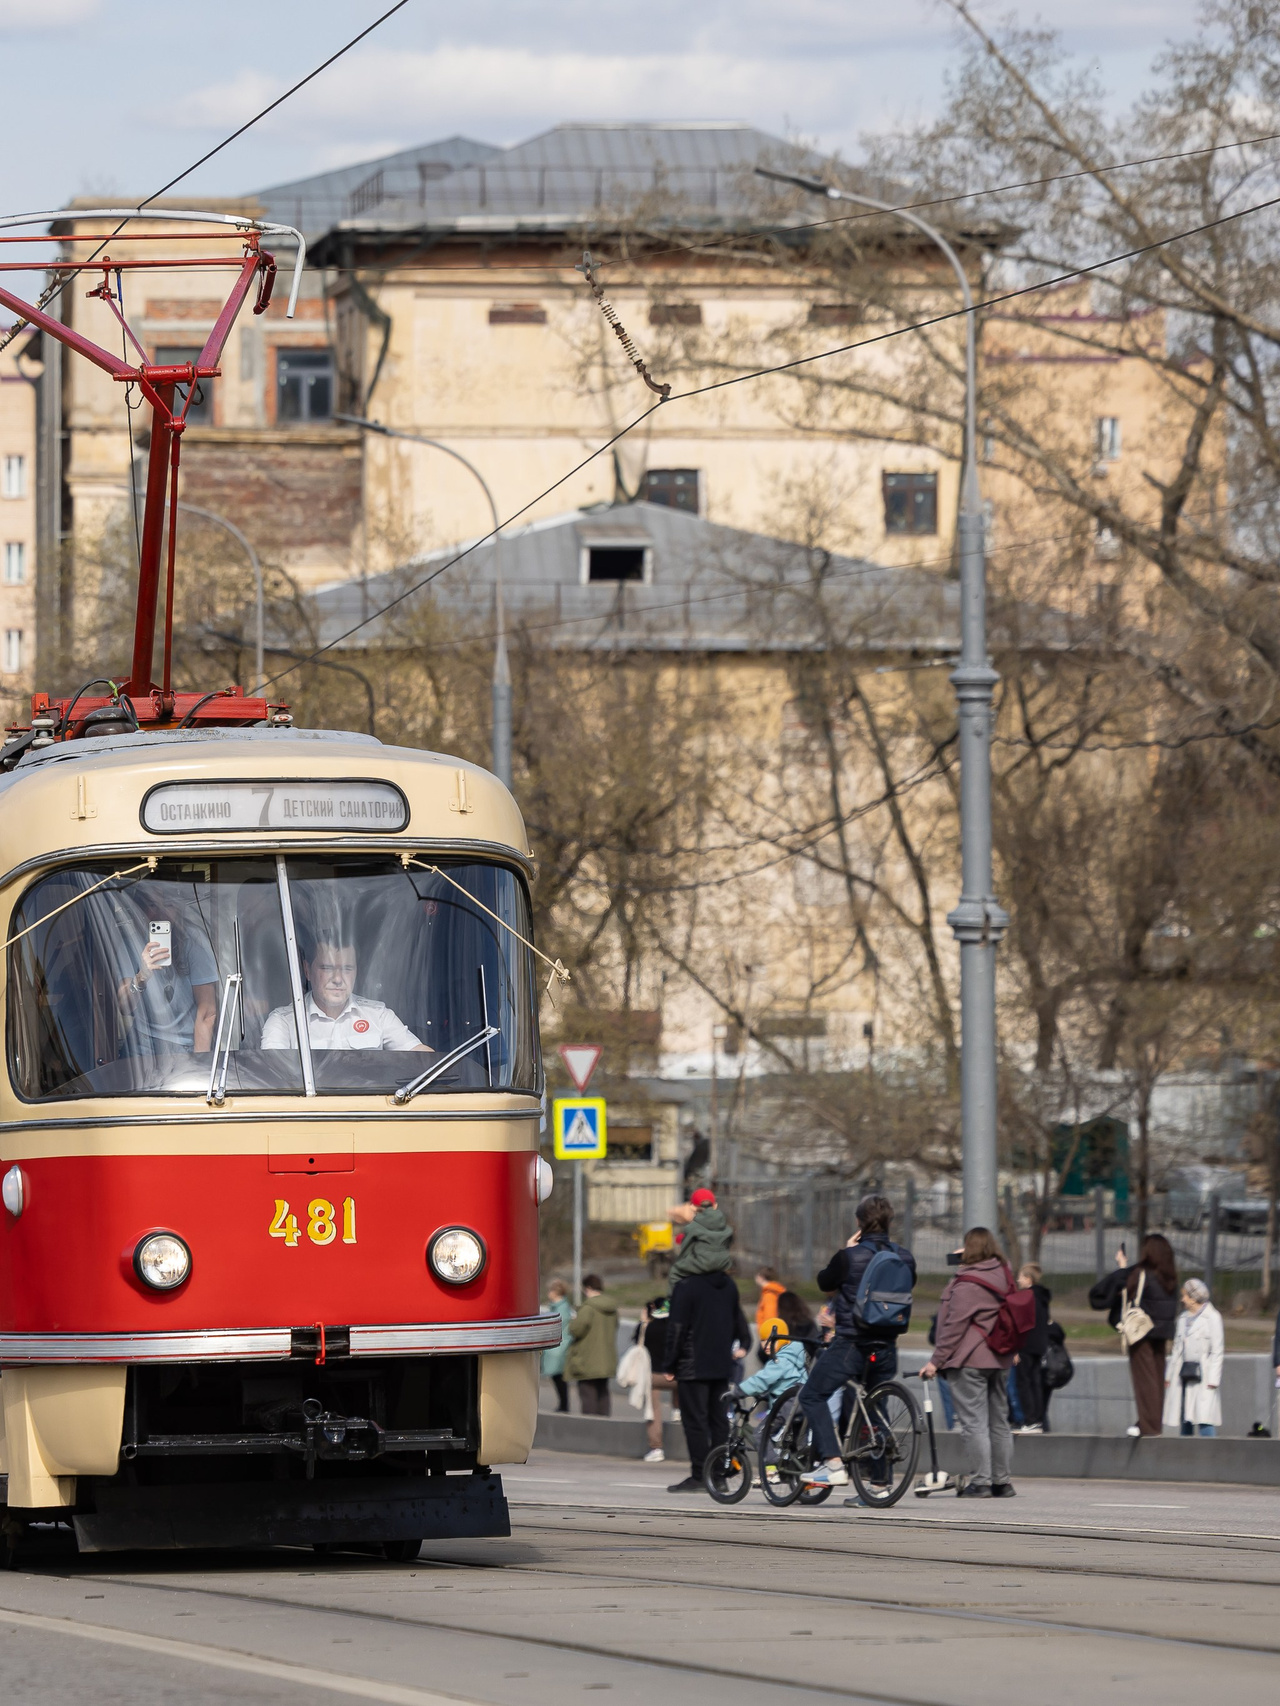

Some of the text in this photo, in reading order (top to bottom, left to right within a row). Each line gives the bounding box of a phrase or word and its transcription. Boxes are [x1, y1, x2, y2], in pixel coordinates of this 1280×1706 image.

[160, 801, 232, 822] ОСТАНКИНО
[251, 787, 274, 826] 7
[283, 798, 334, 819] ДЕТСКИЙ
[268, 1196, 358, 1247] 481
